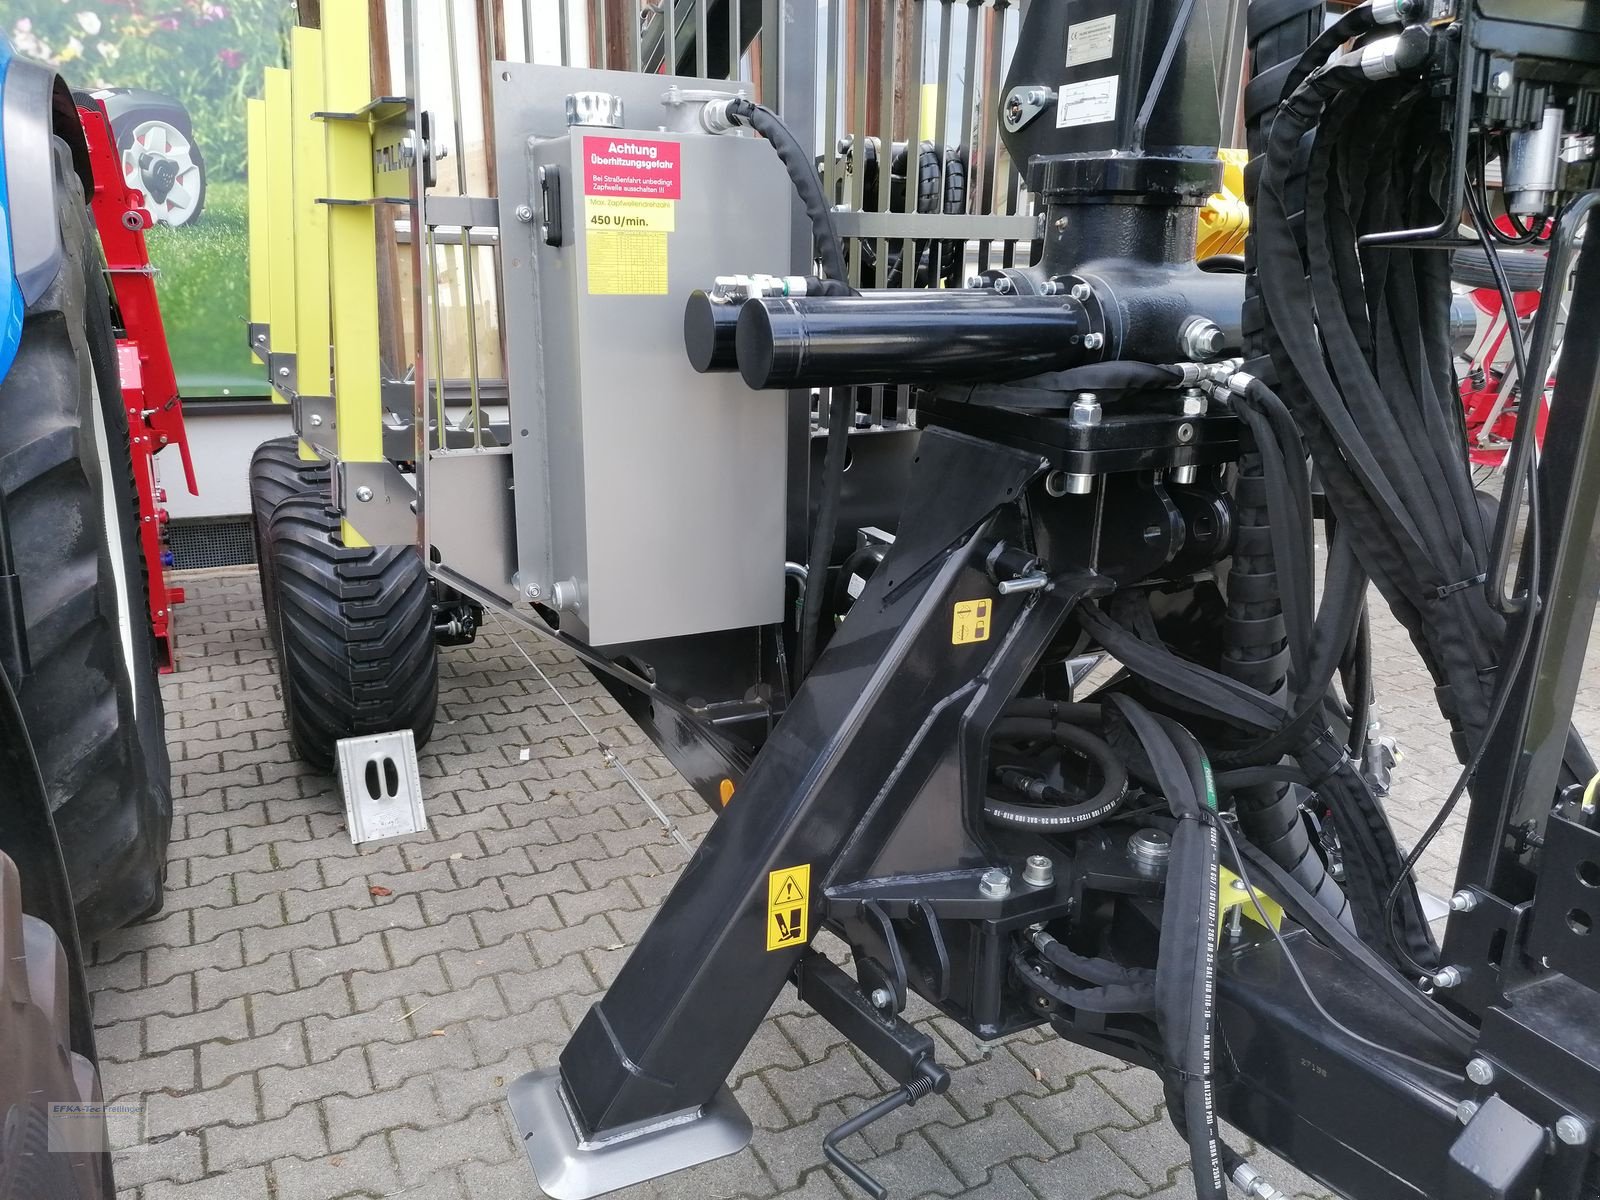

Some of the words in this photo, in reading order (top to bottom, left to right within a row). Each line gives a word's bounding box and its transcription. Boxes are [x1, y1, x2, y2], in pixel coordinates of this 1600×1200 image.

[608, 142, 657, 158] Achtung
[591, 153, 673, 170] Überhitzungsgefahr
[592, 175, 603, 183] Bei
[604, 175, 641, 185] Straßenfahrt
[642, 178, 673, 188] unbedingt
[592, 183, 622, 192] Zapfwelle
[624, 184, 657, 194] ausschalten
[590, 199, 606, 207] Max.
[607, 199, 671, 209] Zapfwellendrehzahl
[591, 215, 611, 225] 450
[613, 216, 649, 228] U/min.
[1203, 1034, 1211, 1049] MAX
[1203, 1050, 1210, 1060] WP
